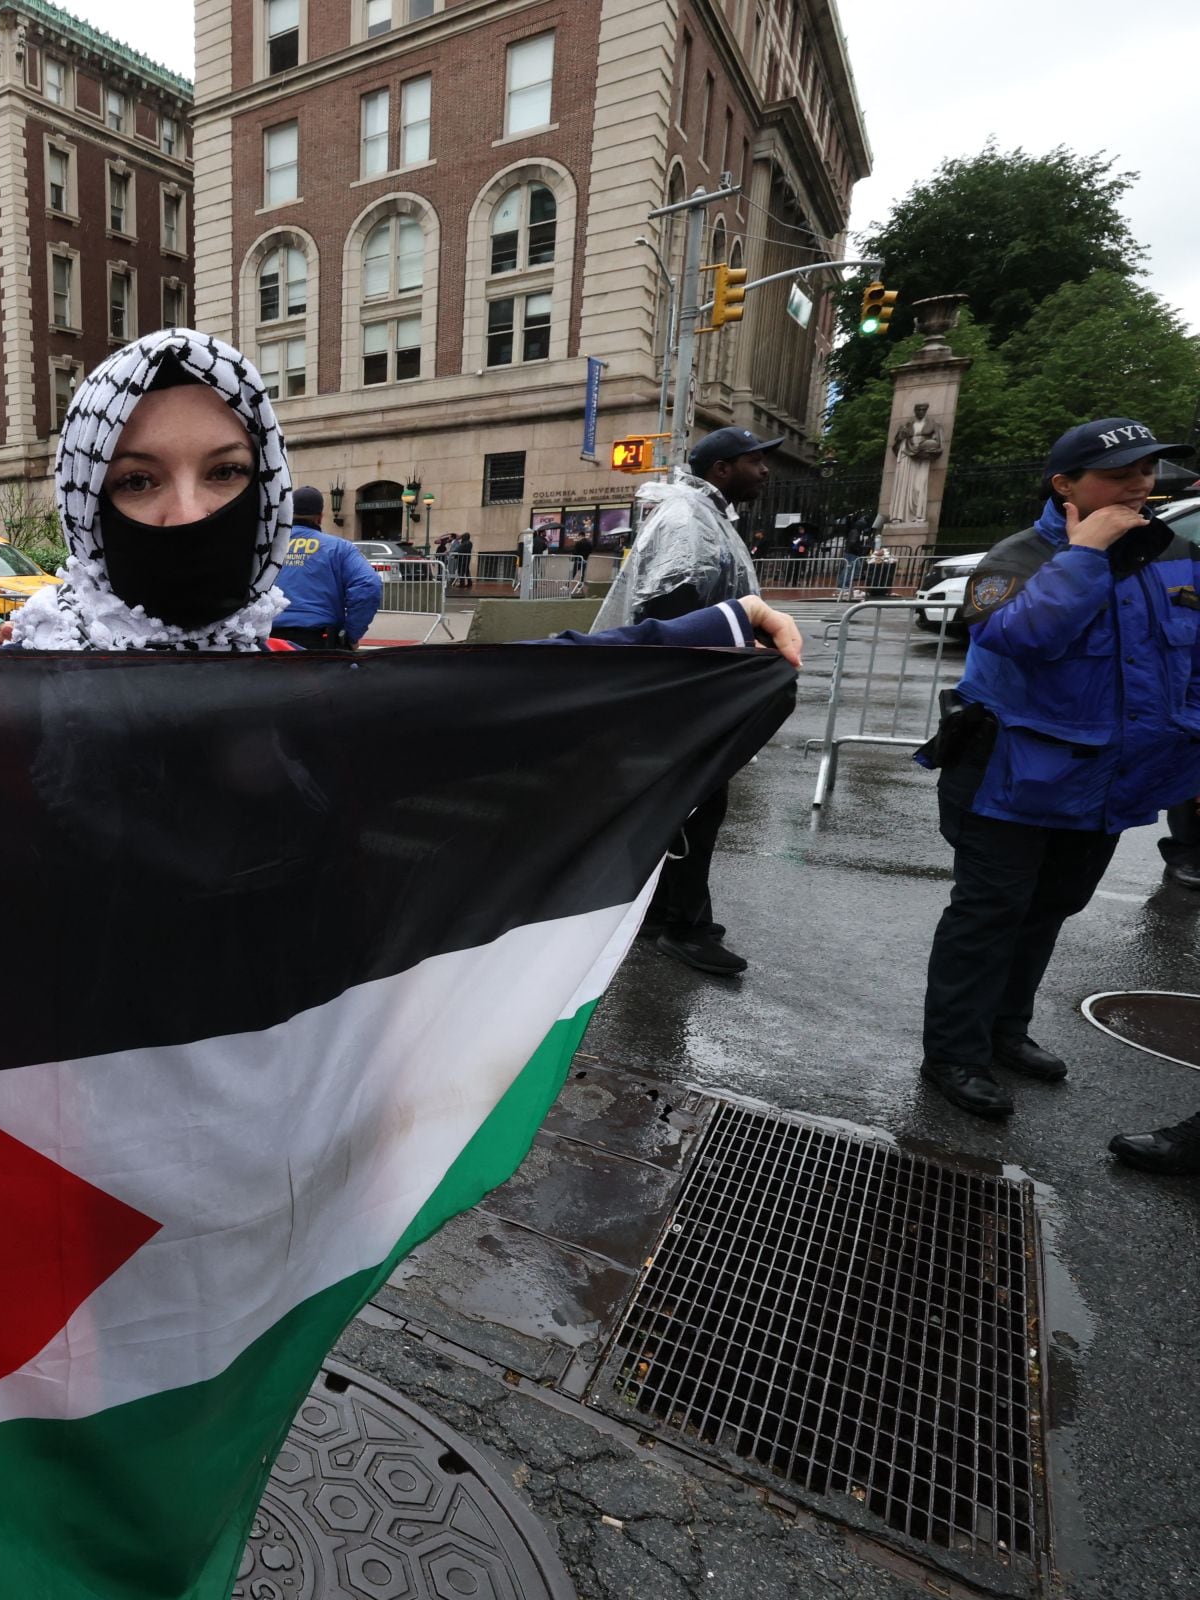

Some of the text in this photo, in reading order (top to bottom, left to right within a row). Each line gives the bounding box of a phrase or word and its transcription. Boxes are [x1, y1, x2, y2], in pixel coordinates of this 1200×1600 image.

[627, 445, 644, 463] 21
[533, 486, 636, 498] COLUMBIA UNIVERSITY
[288, 538, 320, 553] YPD
[285, 559, 305, 567] FAIRS
